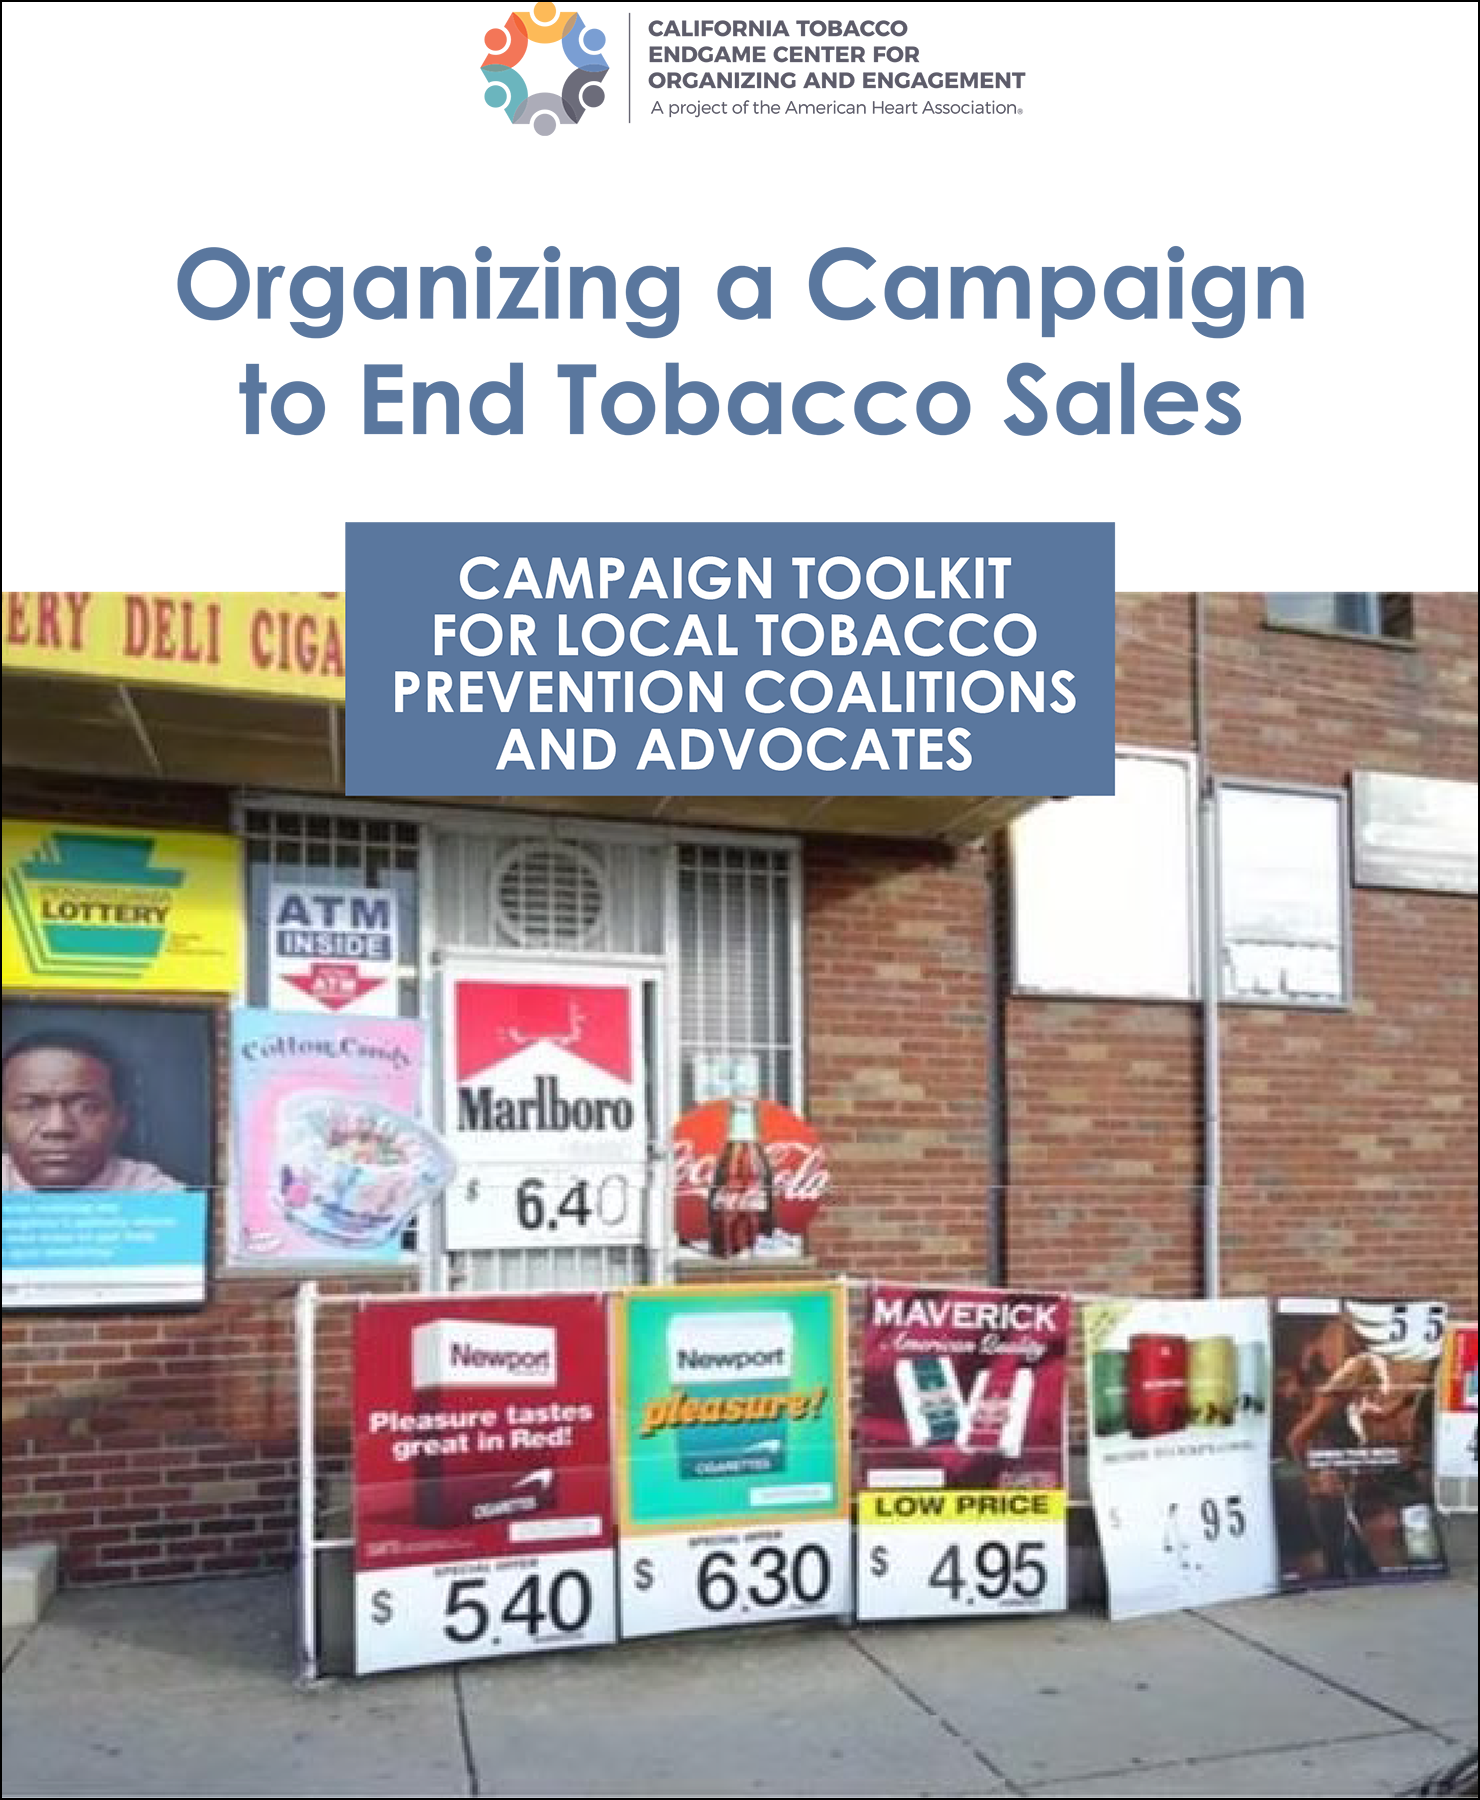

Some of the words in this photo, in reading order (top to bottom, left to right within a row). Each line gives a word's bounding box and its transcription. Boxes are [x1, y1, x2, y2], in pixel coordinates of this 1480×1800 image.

[123, 596, 221, 664] DELI
[250, 608, 345, 678] CIGA
[43, 900, 171, 922] LOTTERY
[276, 893, 392, 930] ATM
[283, 932, 384, 956] INSIDE
[457, 1074, 634, 1131] Marlboro
[515, 1173, 629, 1231] 6.40
[873, 1298, 1057, 1331] MAVERICK
[449, 1341, 549, 1373] Newport
[675, 1347, 785, 1370] Newport
[368, 1409, 497, 1434] Pleasure
[507, 1402, 595, 1426] tastes
[639, 1382, 828, 1440] pleasure!
[392, 1432, 470, 1462] great
[477, 1430, 505, 1452] in
[510, 1426, 575, 1450] Red!
[875, 1496, 945, 1517] LOW
[957, 1494, 1050, 1515] PRICE
[633, 1556, 655, 1592] $
[697, 1543, 831, 1612] 6.30
[870, 1544, 890, 1579] $
[928, 1540, 1048, 1605] 4.95
[370, 1588, 394, 1626] $
[443, 1568, 593, 1645] 5.40
